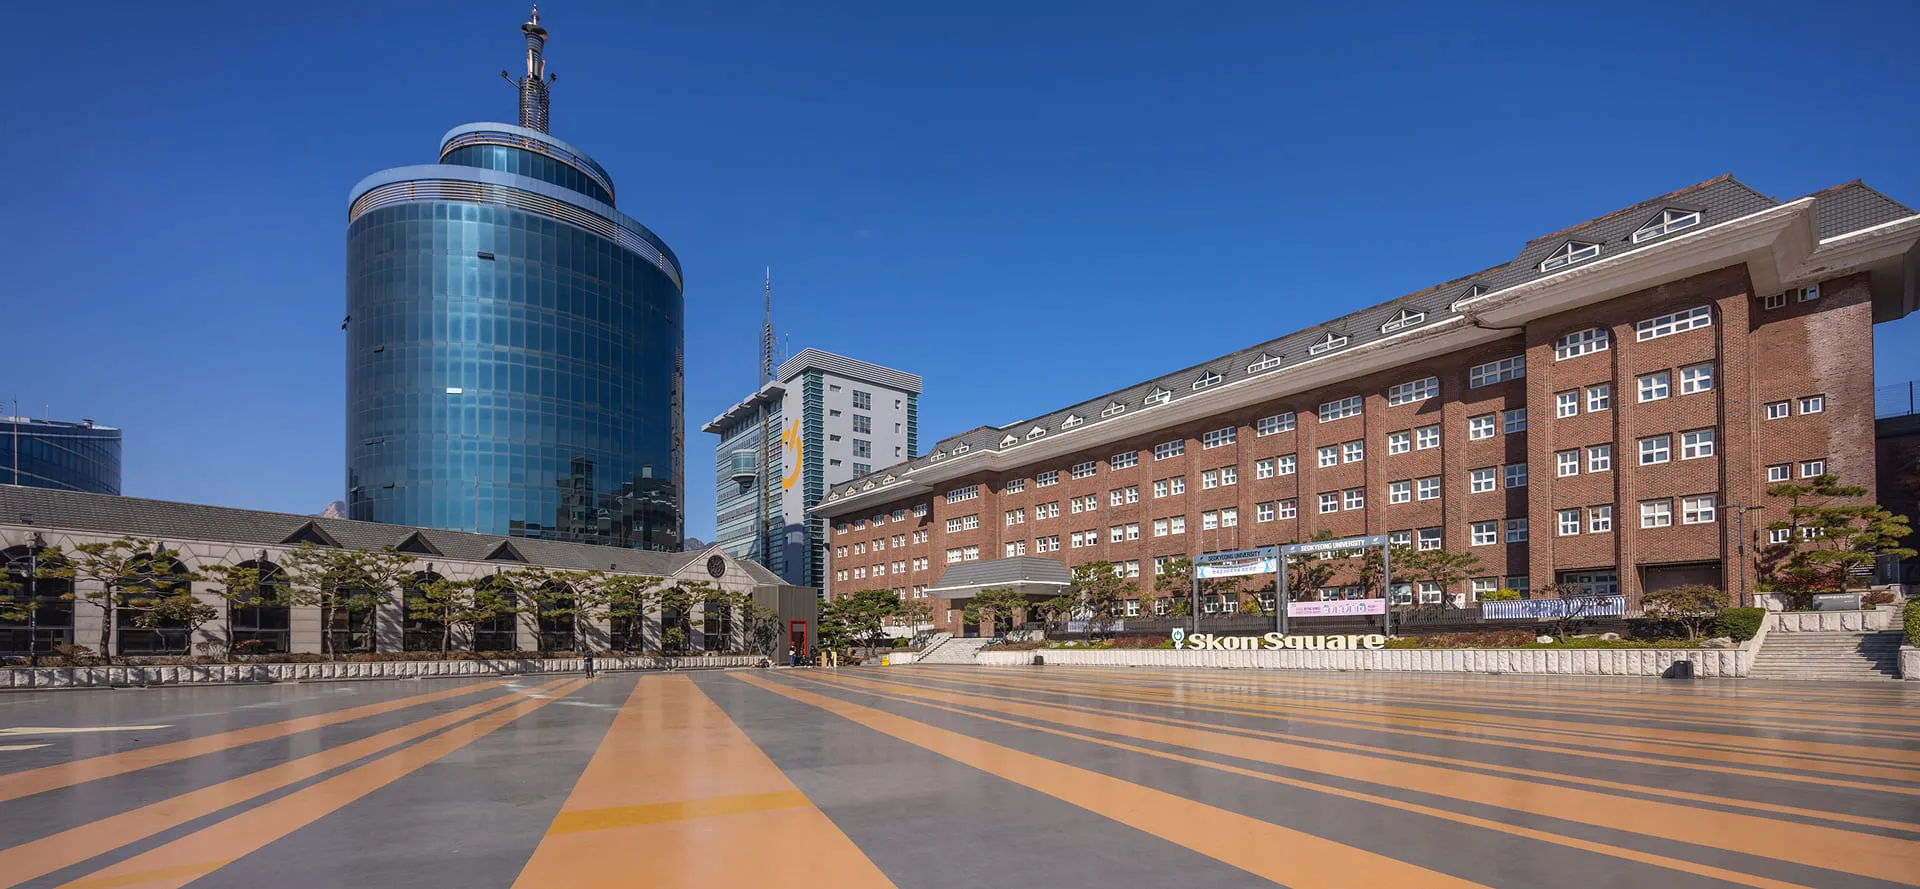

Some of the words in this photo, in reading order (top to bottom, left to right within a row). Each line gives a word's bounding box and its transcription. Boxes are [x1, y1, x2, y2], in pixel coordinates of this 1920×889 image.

[1301, 543, 1332, 552] SEOKYEONG
[1333, 539, 1365, 549] UNIVERSITY
[1208, 553, 1233, 562] SEOKYEONG
[1235, 550, 1261, 559] UNIVERSITY
[1188, 633, 1259, 651] Skon
[1263, 632, 1385, 651] Square
